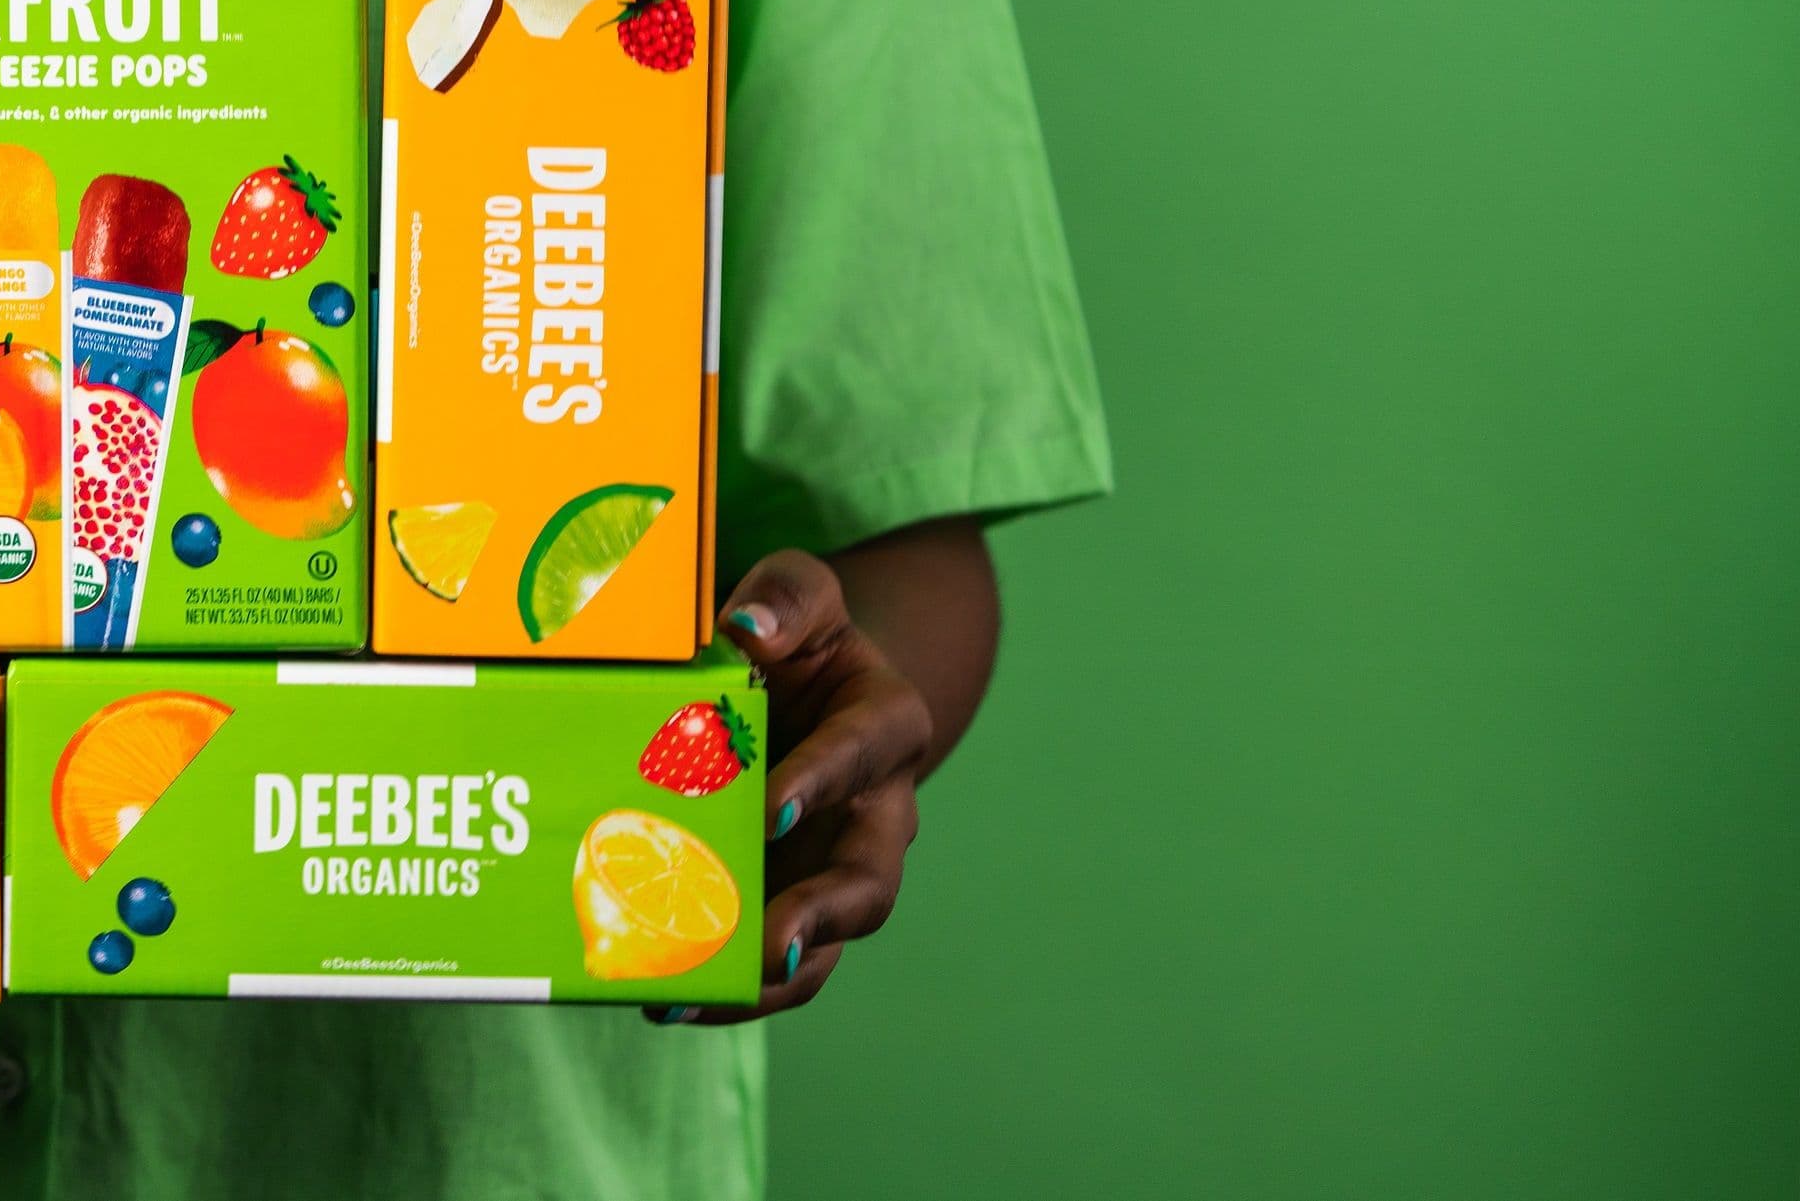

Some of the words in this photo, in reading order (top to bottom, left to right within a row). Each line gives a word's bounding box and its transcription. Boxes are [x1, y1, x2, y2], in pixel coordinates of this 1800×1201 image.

[112, 54, 207, 87] POPS
[49, 106, 61, 121] &
[64, 106, 109, 121] other
[112, 106, 172, 122] organic
[177, 105, 268, 122] ingredients
[481, 194, 522, 375] ORGANICS
[523, 146, 608, 425] DEEBEE'S
[19, 303, 45, 312] OTHER
[87, 296, 156, 317] BLUEBERRY
[74, 306, 164, 332] POMEGRANATE
[75, 329, 106, 341] FLAVOR
[108, 335, 130, 345] WITH
[132, 340, 160, 352] OTHER
[78, 340, 114, 353] NATURAL
[117, 347, 153, 360] FLAVORS
[74, 563, 94, 578] DA
[73, 583, 97, 598] ANIC
[185, 588, 199, 603] 25
[232, 588, 244, 603] FL
[247, 588, 261, 603] OZ
[262, 587, 280, 604] (40
[306, 588, 333, 603] BARS
[185, 608, 206, 624] NET
[228, 608, 258, 624] 33.75
[260, 608, 272, 624] FL
[274, 608, 289, 624] OZ
[290, 608, 319, 625] (1000
[254, 769, 530, 856] DEEBEE'S
[302, 856, 481, 897] ORGANICS
